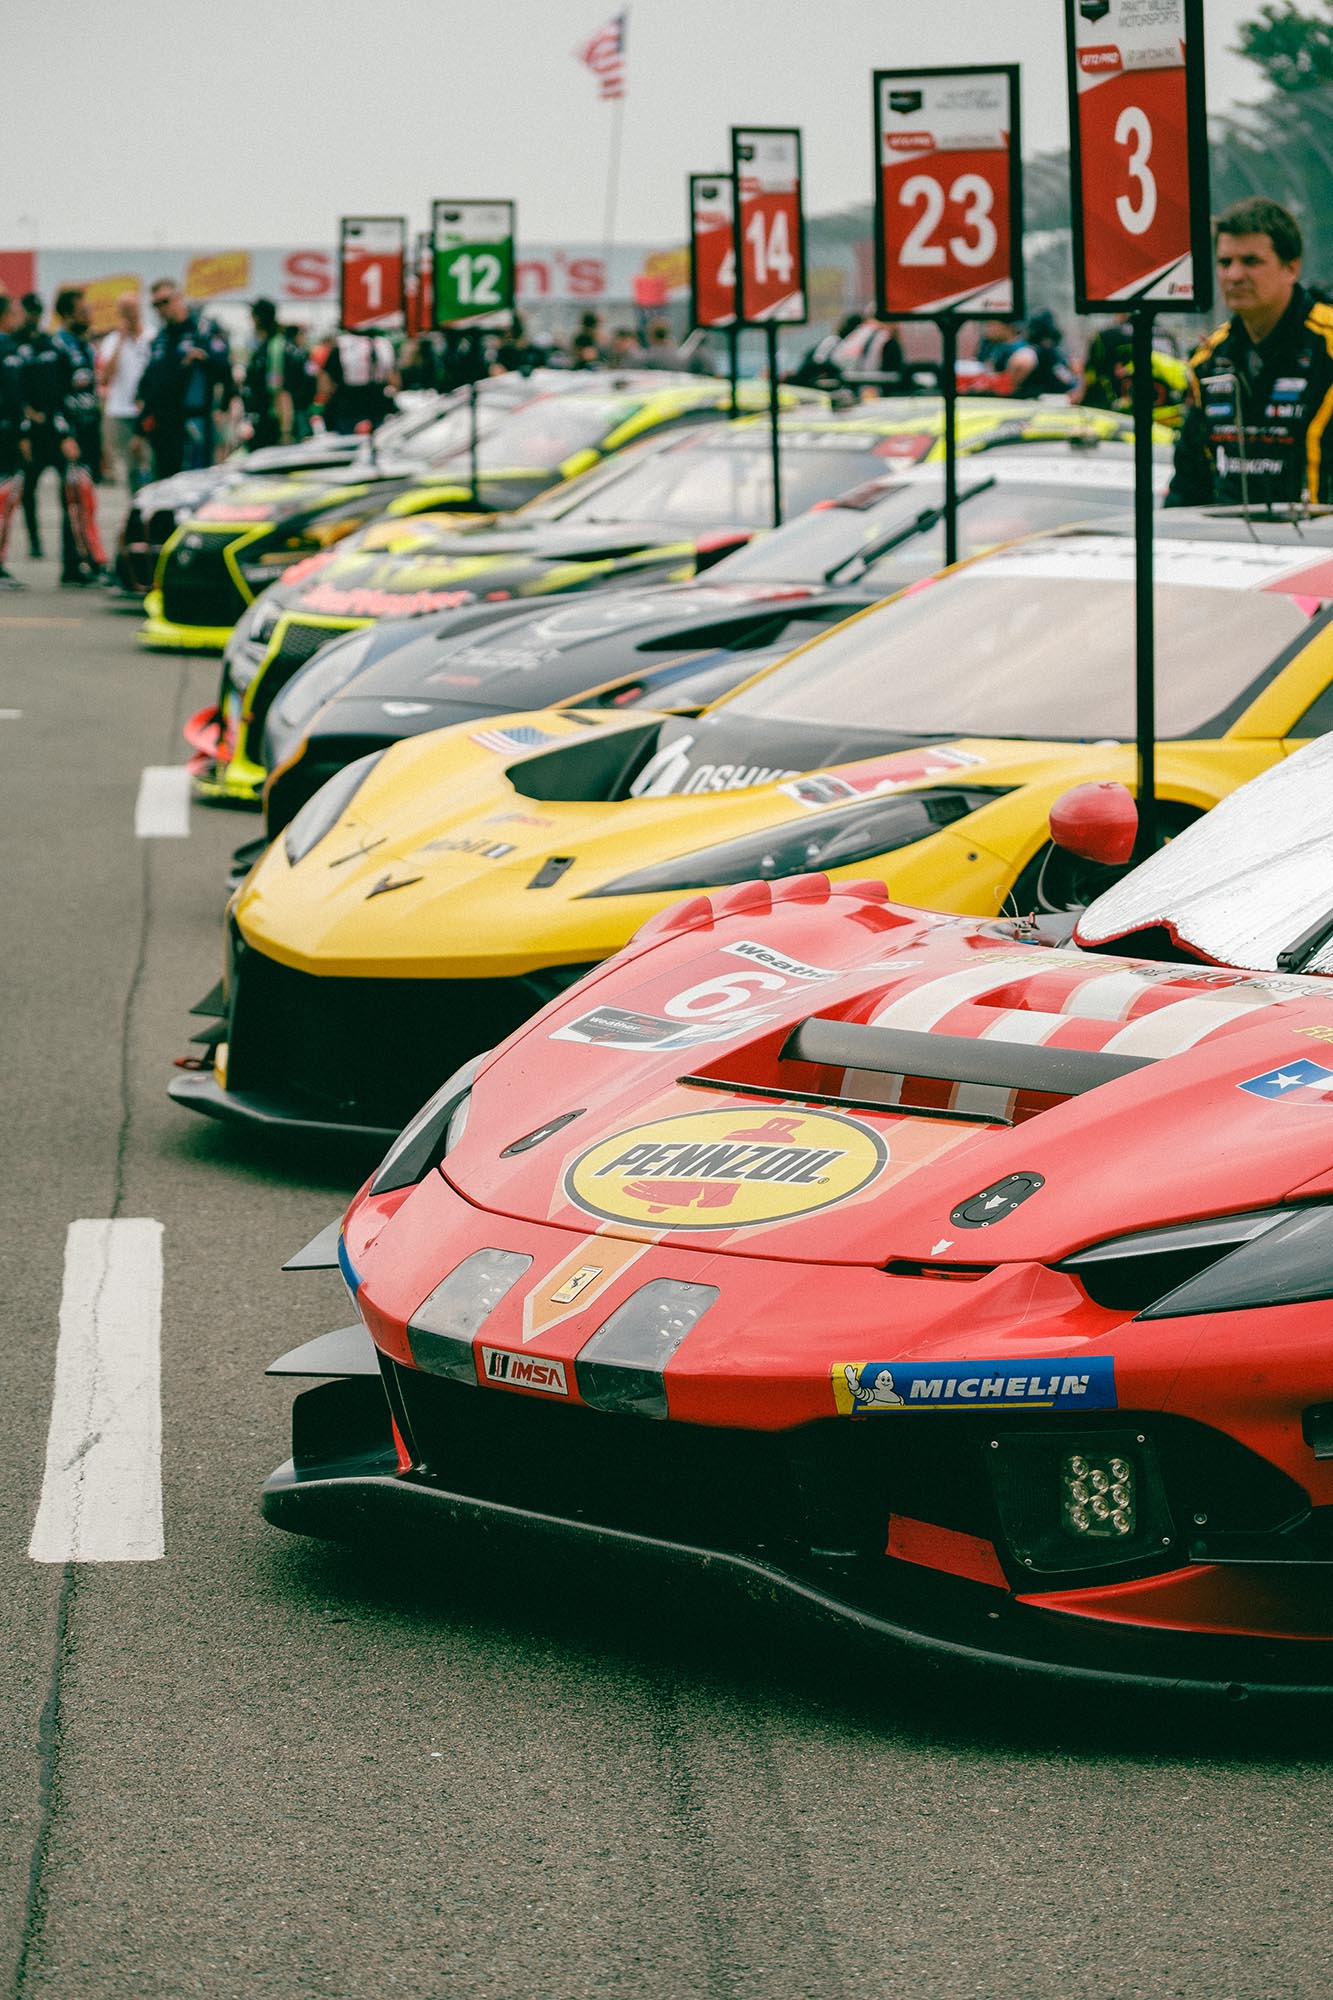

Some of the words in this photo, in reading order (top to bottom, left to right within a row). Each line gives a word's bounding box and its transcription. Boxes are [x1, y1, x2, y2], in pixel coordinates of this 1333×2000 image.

[1115, 106, 1157, 235] 3
[899, 174, 998, 267] 23
[746, 210, 794, 285] 14
[360, 263, 383, 310] 1
[449, 254, 502, 305] 12
[595, 1143, 846, 1184] PENNZOIL
[511, 1360, 564, 1388] IMSA
[909, 1374, 1090, 1399] MICHELIN
